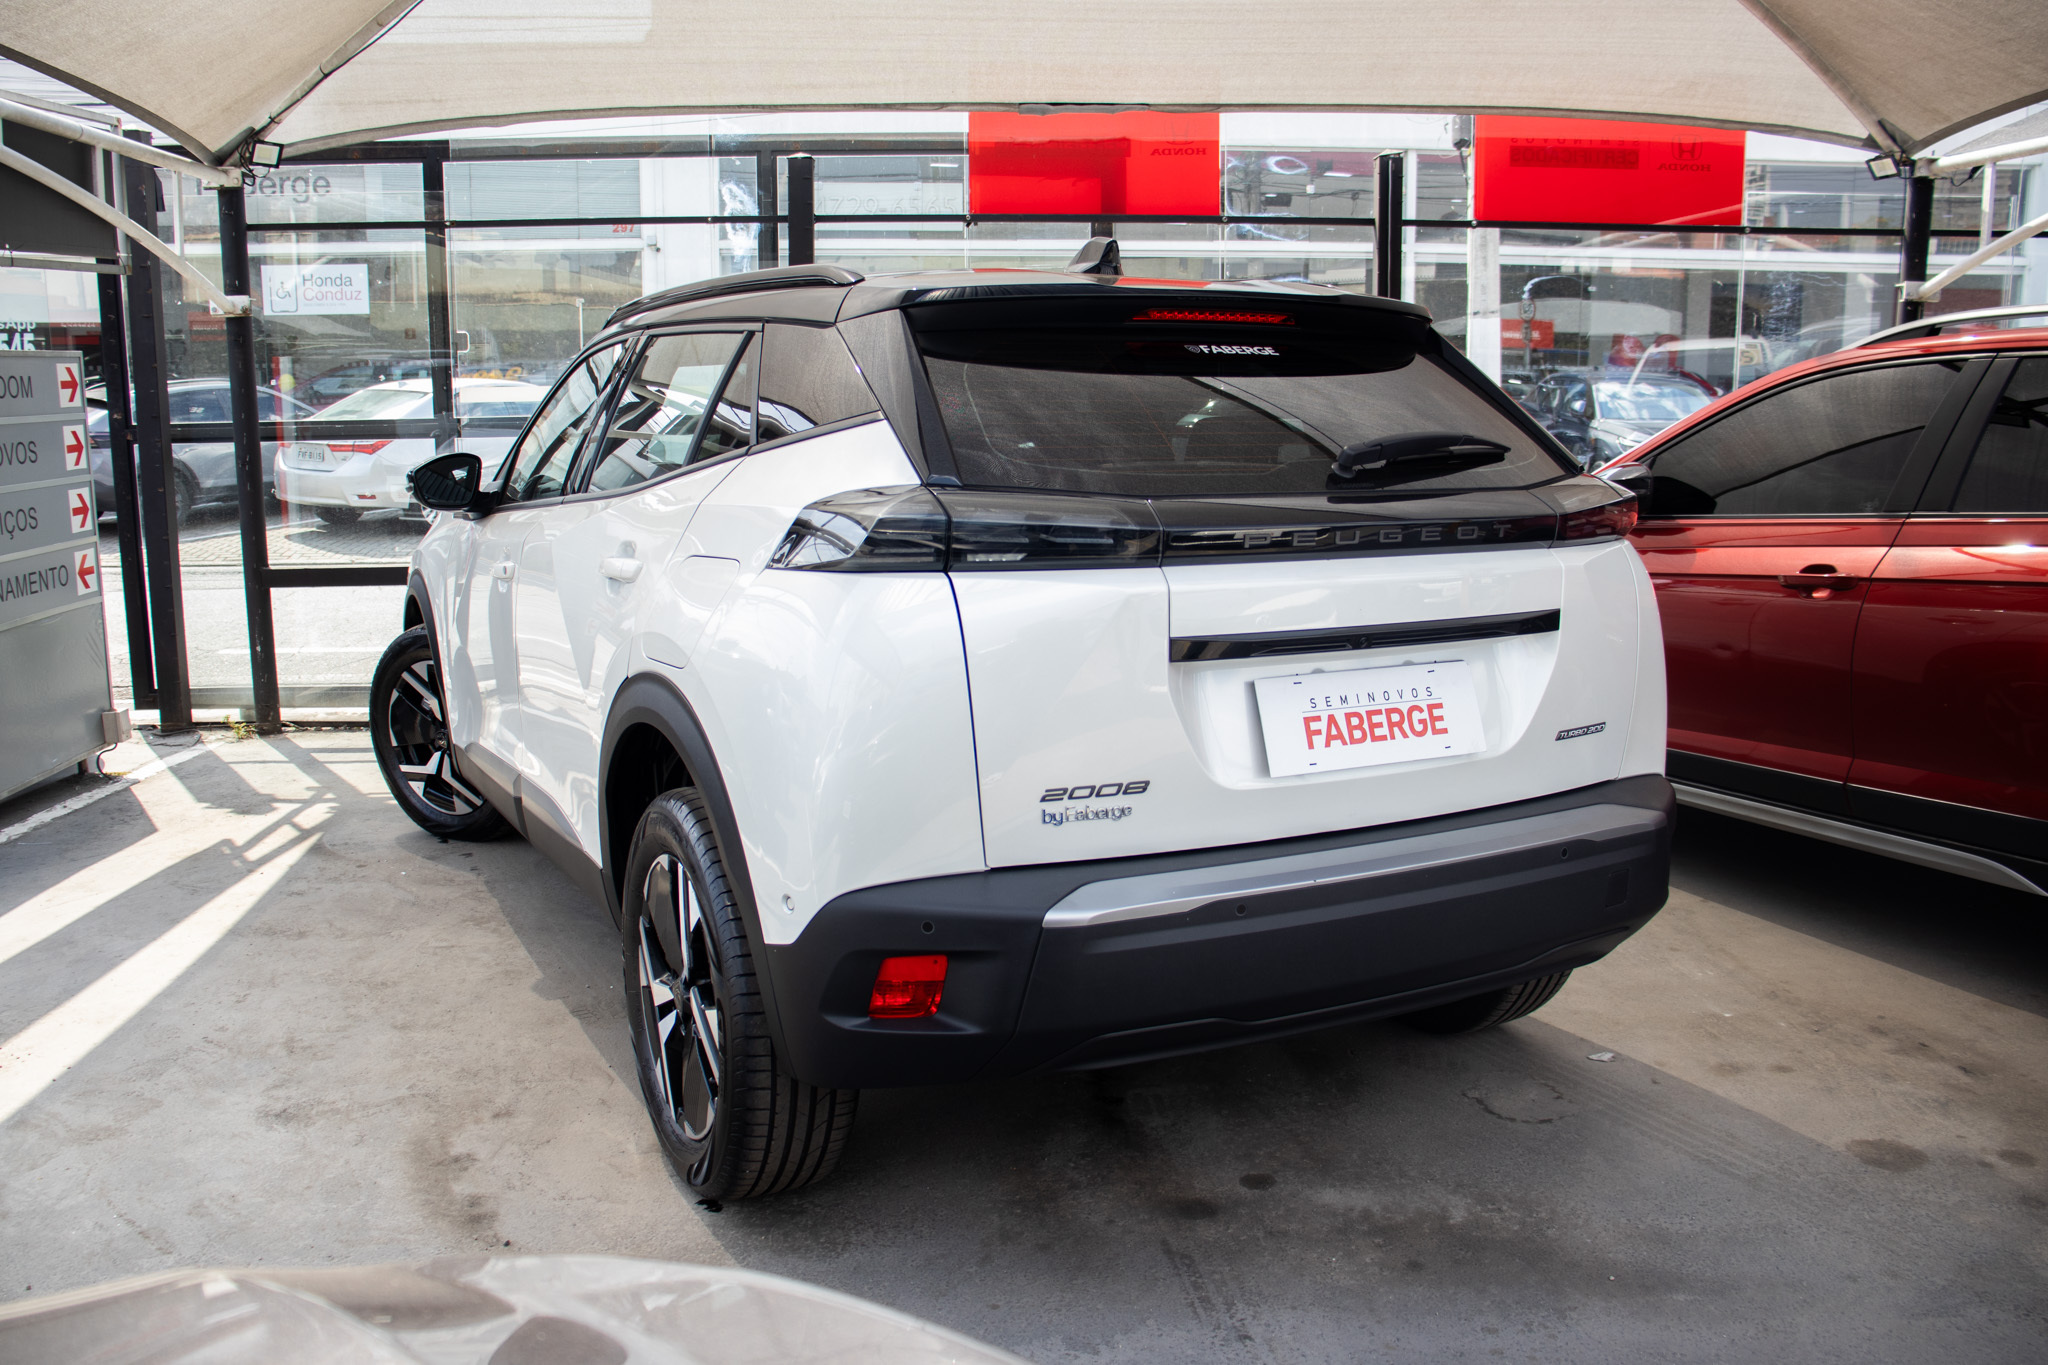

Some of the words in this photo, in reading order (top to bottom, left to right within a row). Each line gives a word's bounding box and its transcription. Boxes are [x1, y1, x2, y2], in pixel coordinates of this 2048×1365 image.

[612, 223, 634, 233] 297
[303, 273, 352, 287] Honda
[303, 287, 362, 301] Conduz
[1198, 344, 1280, 356] FABERGE
[1243, 523, 1512, 548] PEUGEOT
[1309, 687, 1433, 709] SEMINOVOS
[1302, 702, 1449, 750] FABERGE
[1560, 728, 1587, 739] TURBO
[1587, 724, 1605, 734] 200
[1039, 780, 1151, 803] 2008
[1041, 809, 1064, 826] by
[1065, 804, 1133, 822] Faberge
